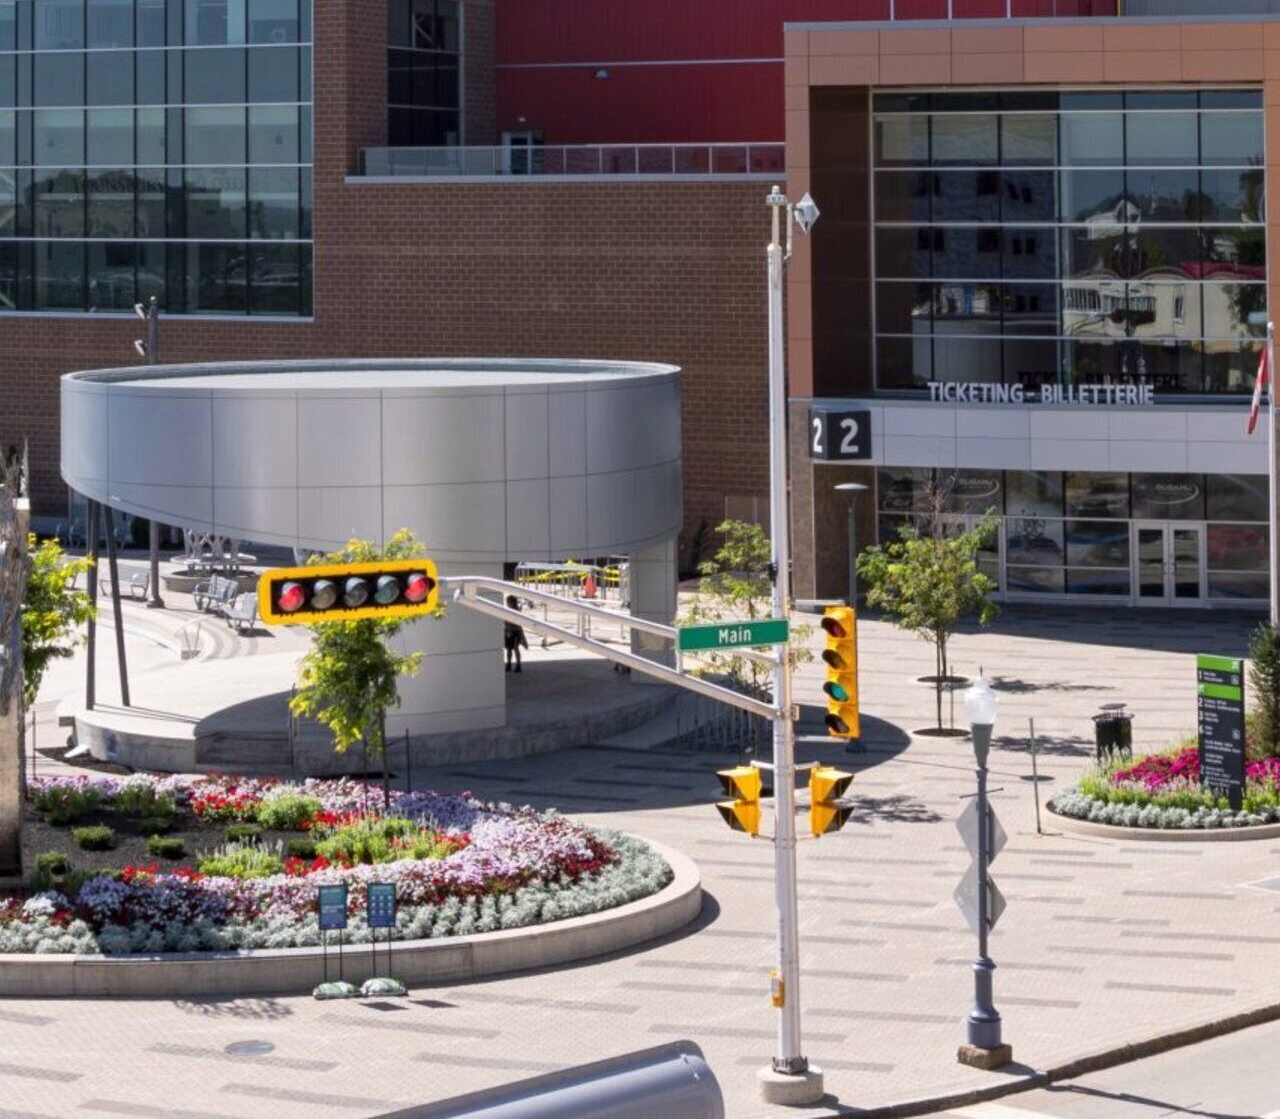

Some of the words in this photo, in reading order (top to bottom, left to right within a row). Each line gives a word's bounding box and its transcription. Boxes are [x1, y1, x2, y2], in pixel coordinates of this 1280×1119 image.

[927, 381, 1024, 404] TICKETING
[1040, 383, 1155, 405] BILLETTERIE
[812, 417, 823, 454] 2
[839, 418, 860, 454] 2
[718, 626, 752, 644] Main
